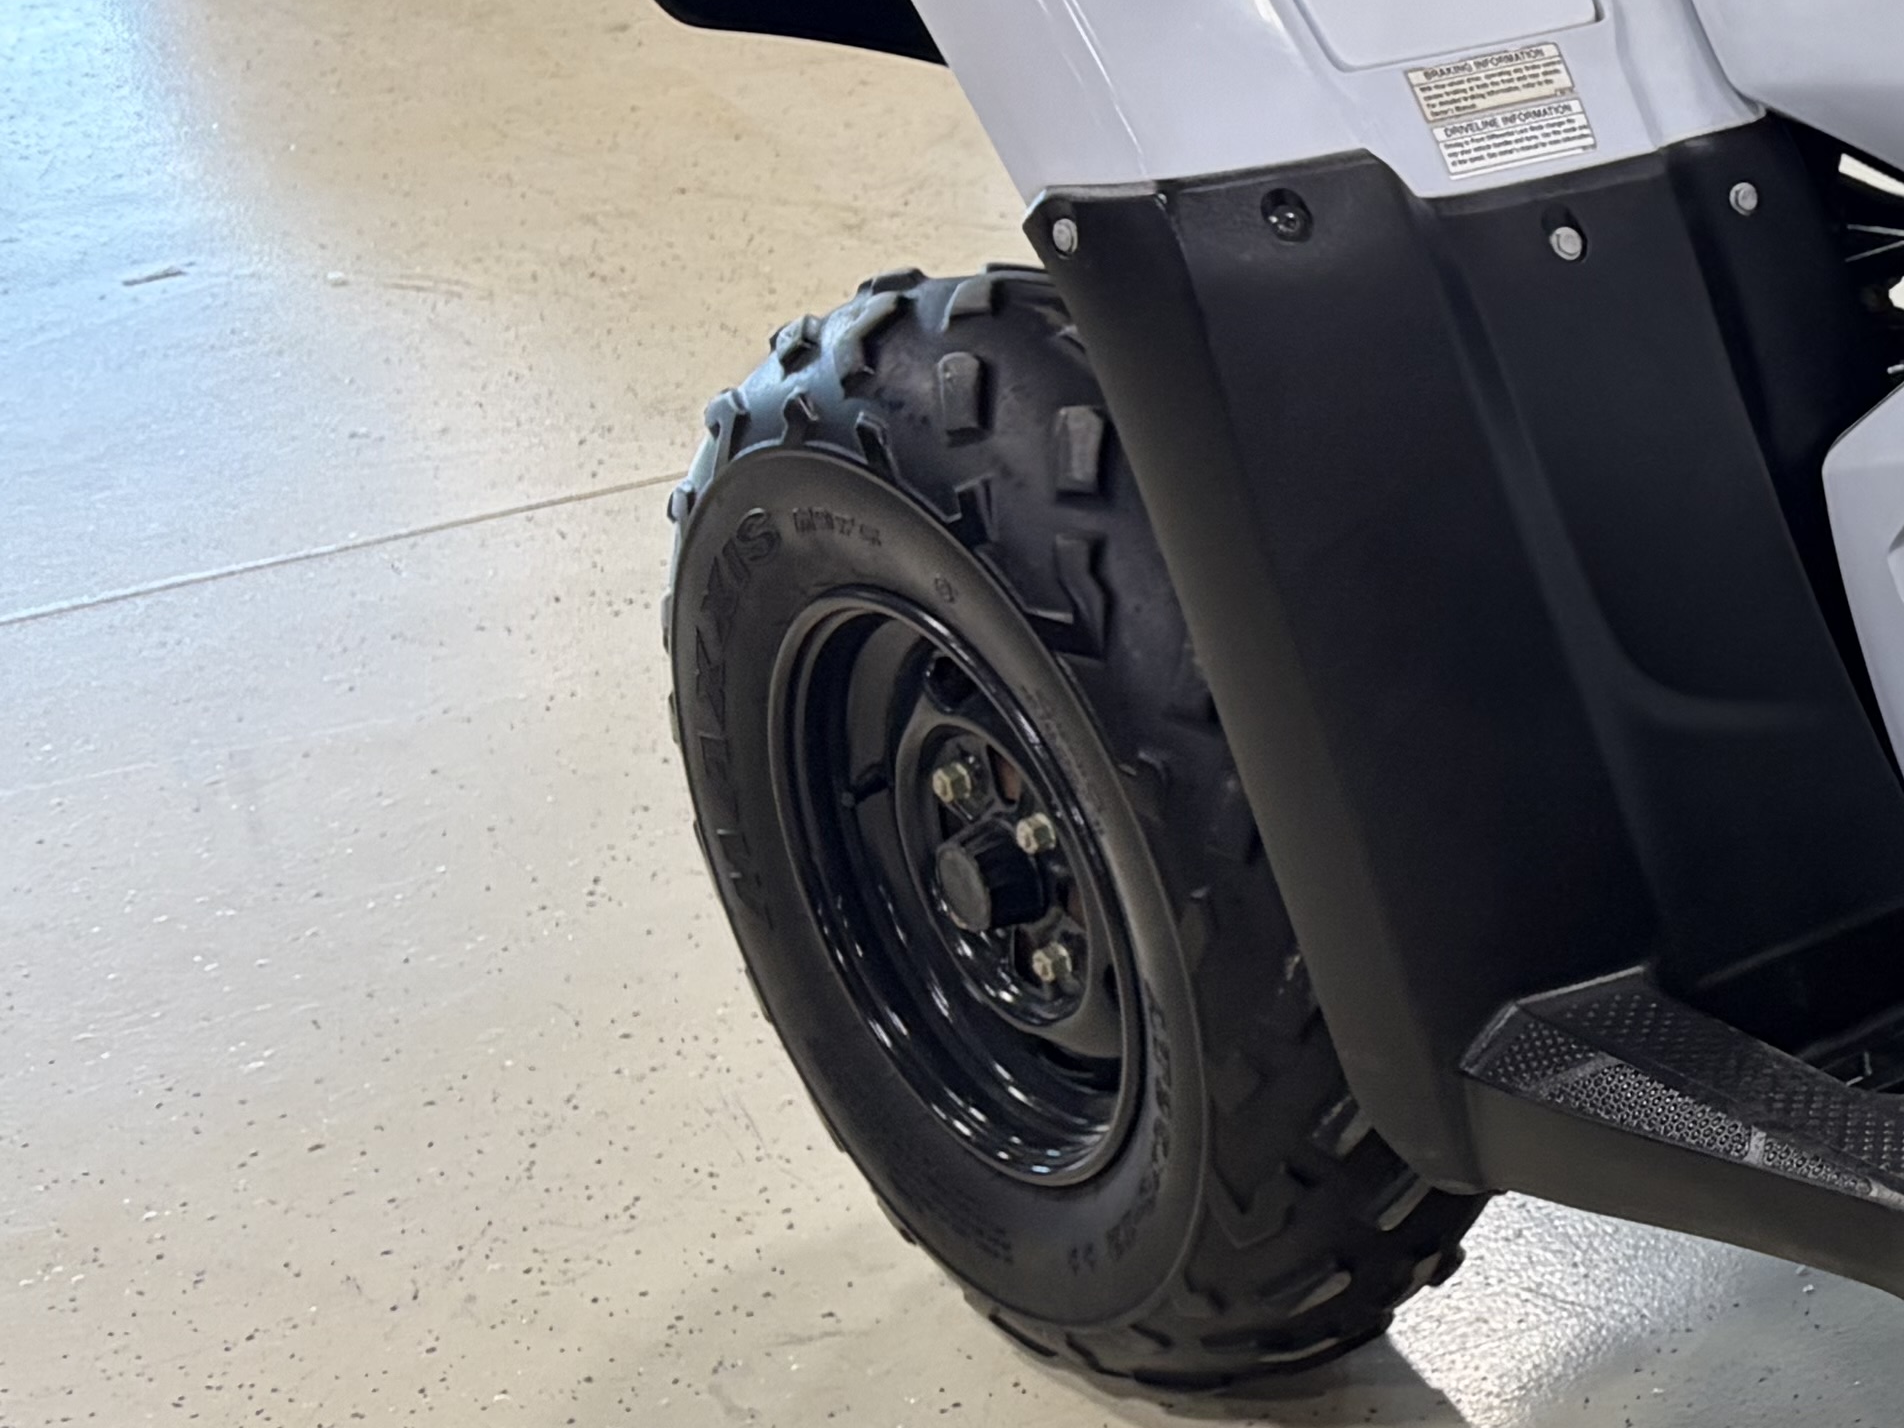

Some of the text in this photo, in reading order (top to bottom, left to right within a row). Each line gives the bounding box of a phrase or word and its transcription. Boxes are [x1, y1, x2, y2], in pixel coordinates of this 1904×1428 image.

[1474, 47, 1545, 70] INFORMATION
[1444, 103, 1573, 138] DRIVELINE INFORMATION
